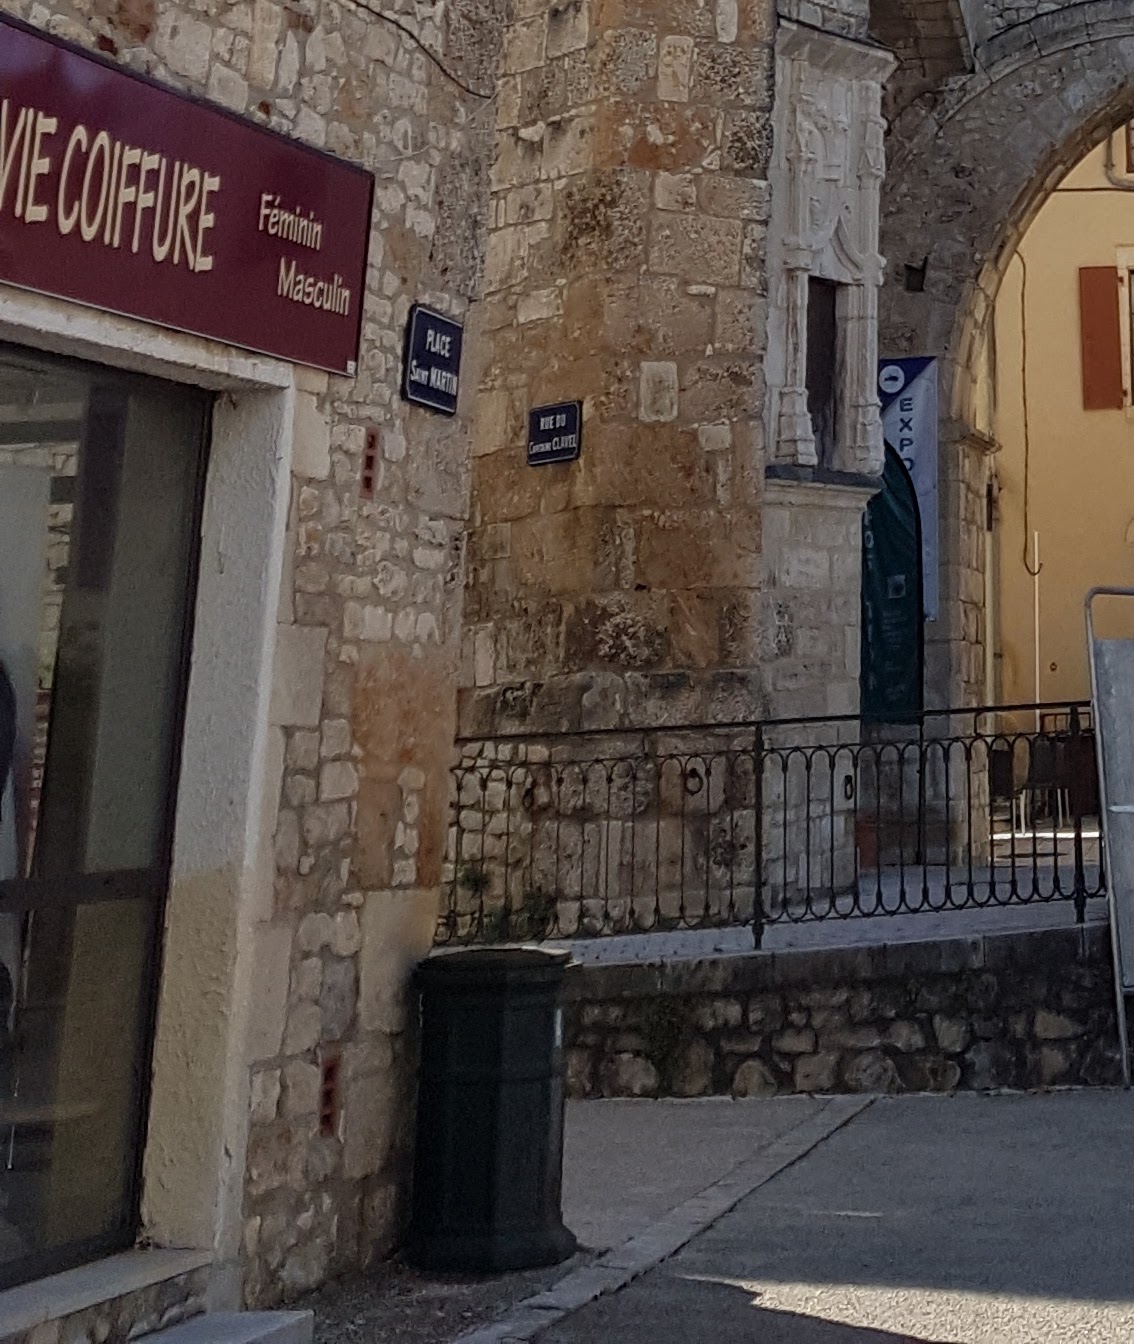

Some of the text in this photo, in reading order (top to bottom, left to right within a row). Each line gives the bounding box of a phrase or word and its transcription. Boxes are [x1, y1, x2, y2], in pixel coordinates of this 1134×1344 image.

[57, 124, 220, 273] COIFFURE
[258, 192, 323, 251] Féminin
[277, 256, 351, 316] Masculin
[425, 329, 451, 358] PLACE
[428, 366, 458, 397] MARTIN
[899, 397, 915, 472] EXPO
